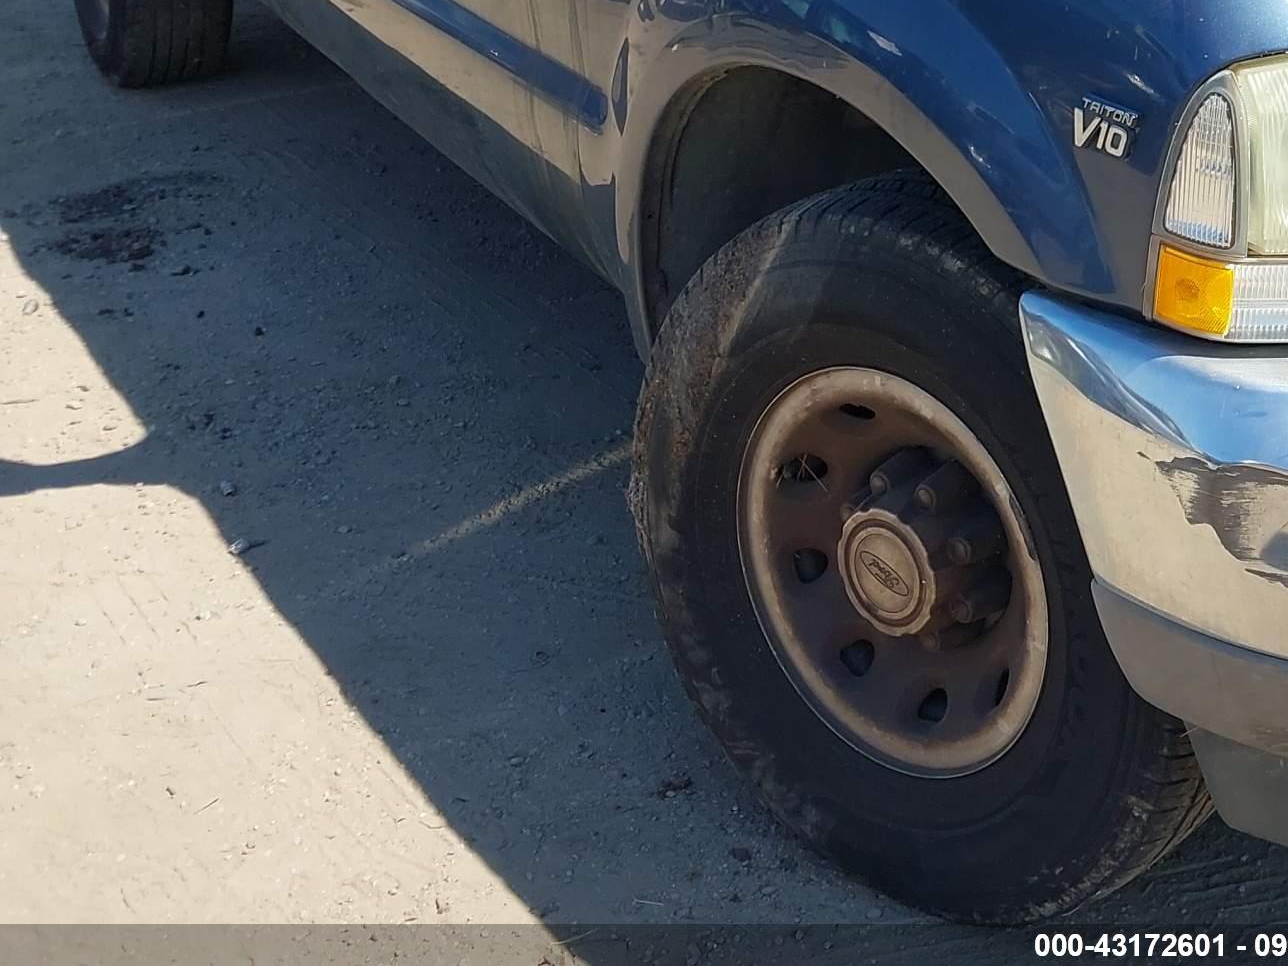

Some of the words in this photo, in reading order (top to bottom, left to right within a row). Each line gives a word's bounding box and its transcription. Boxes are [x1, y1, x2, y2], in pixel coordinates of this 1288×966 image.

[1082, 97, 1136, 126] TRITON
[1074, 107, 1128, 157] V10
[867, 558, 900, 589] Ford
